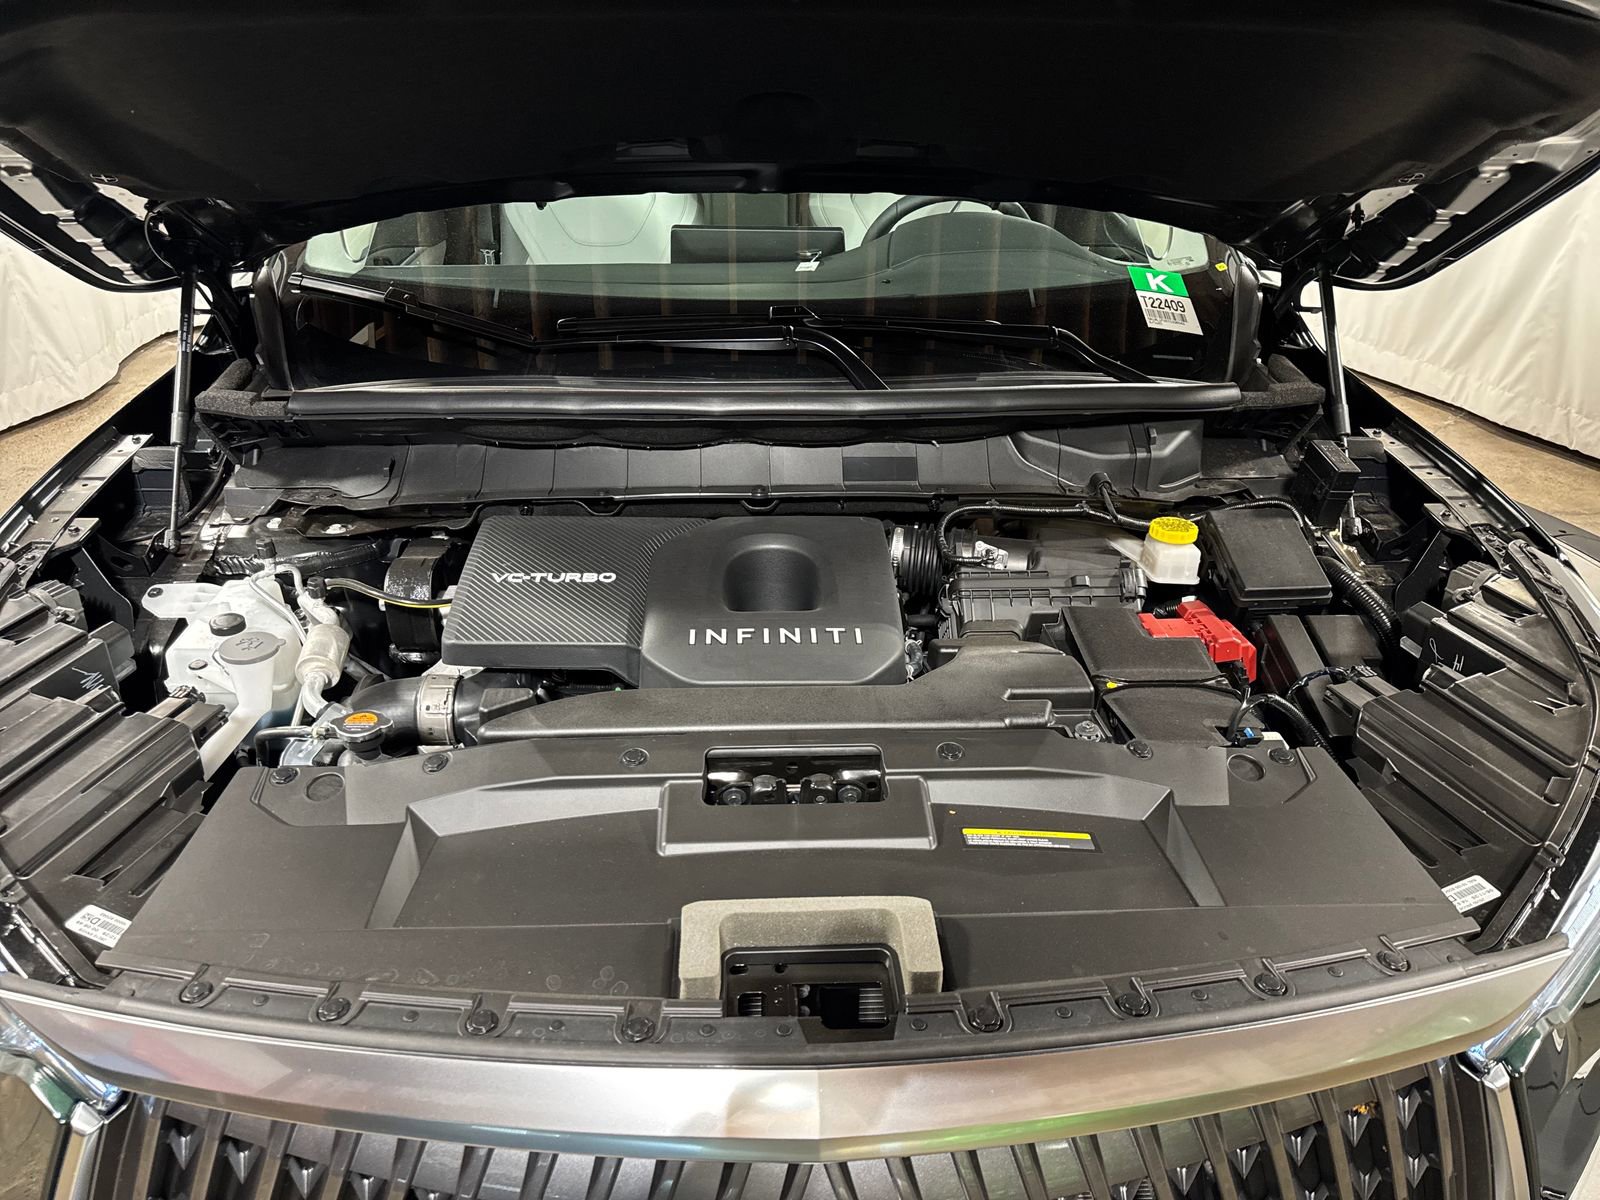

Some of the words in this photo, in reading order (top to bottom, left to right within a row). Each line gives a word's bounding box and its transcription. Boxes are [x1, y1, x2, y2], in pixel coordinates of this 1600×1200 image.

[1146, 272, 1174, 293] K
[1140, 295, 1186, 313] T22409
[491, 572, 617, 583] VC-TURBO
[688, 627, 863, 645] INFINITI
